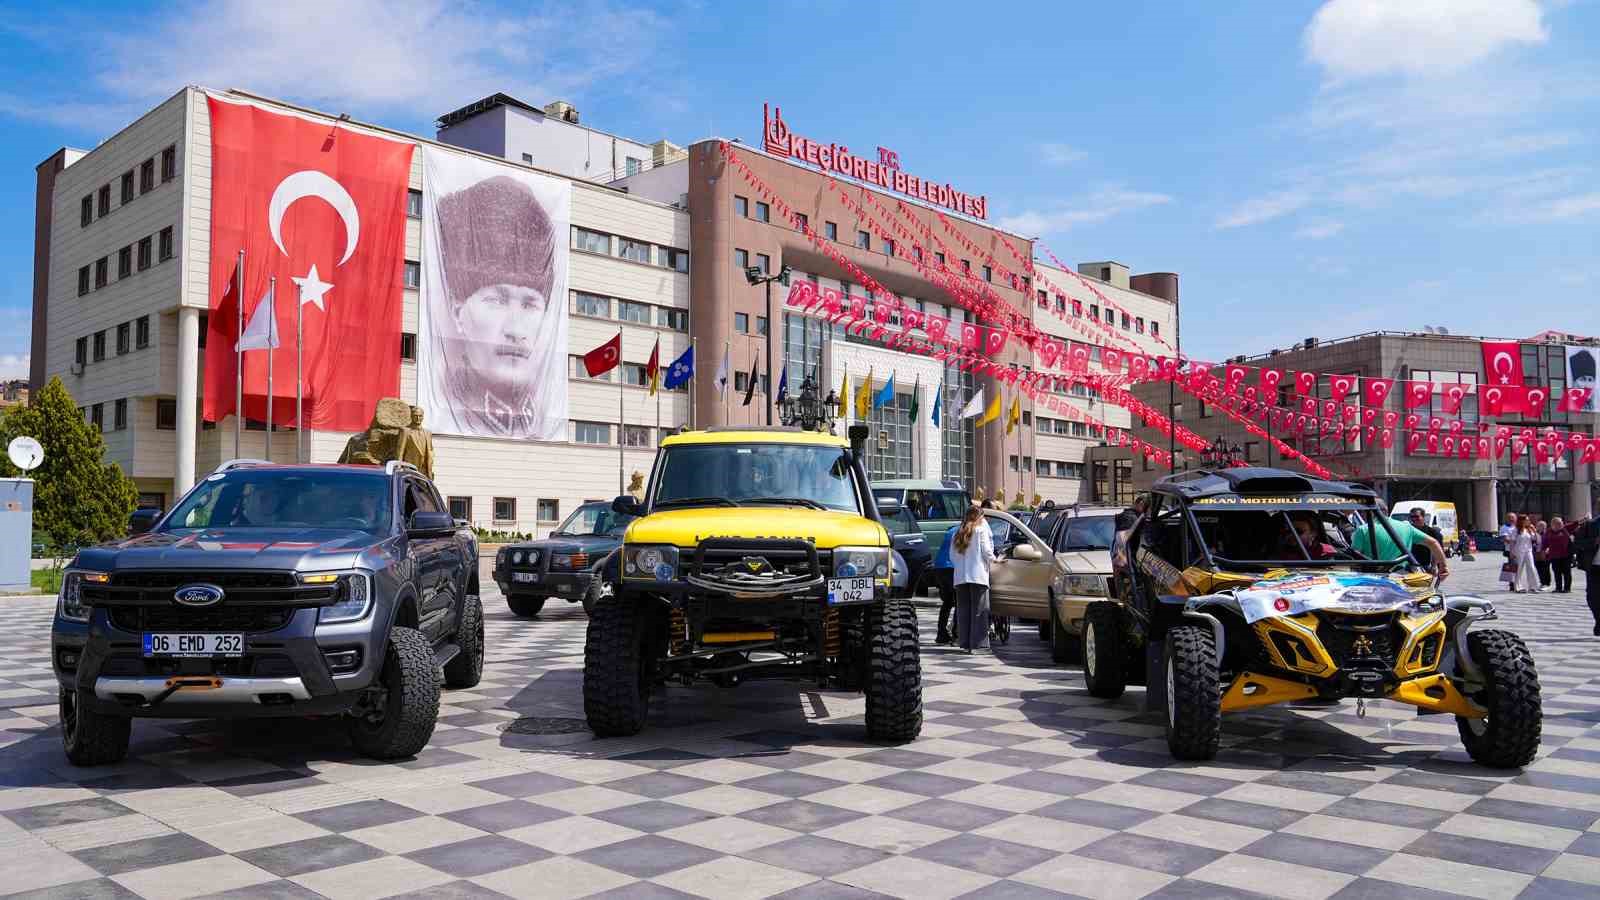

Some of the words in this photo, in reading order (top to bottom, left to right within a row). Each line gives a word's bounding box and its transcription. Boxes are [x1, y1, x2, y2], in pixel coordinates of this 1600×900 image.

[789, 134, 888, 188] KEÇİÖREN
[893, 170, 987, 220] BELEDİYESİ
[830, 581, 842, 591] 34
[852, 579, 872, 590] DBL
[185, 591, 209, 601] Ford
[844, 591, 862, 601] 042
[153, 635, 169, 651] 06
[179, 636, 205, 651] EMD
[215, 636, 241, 651] 252
